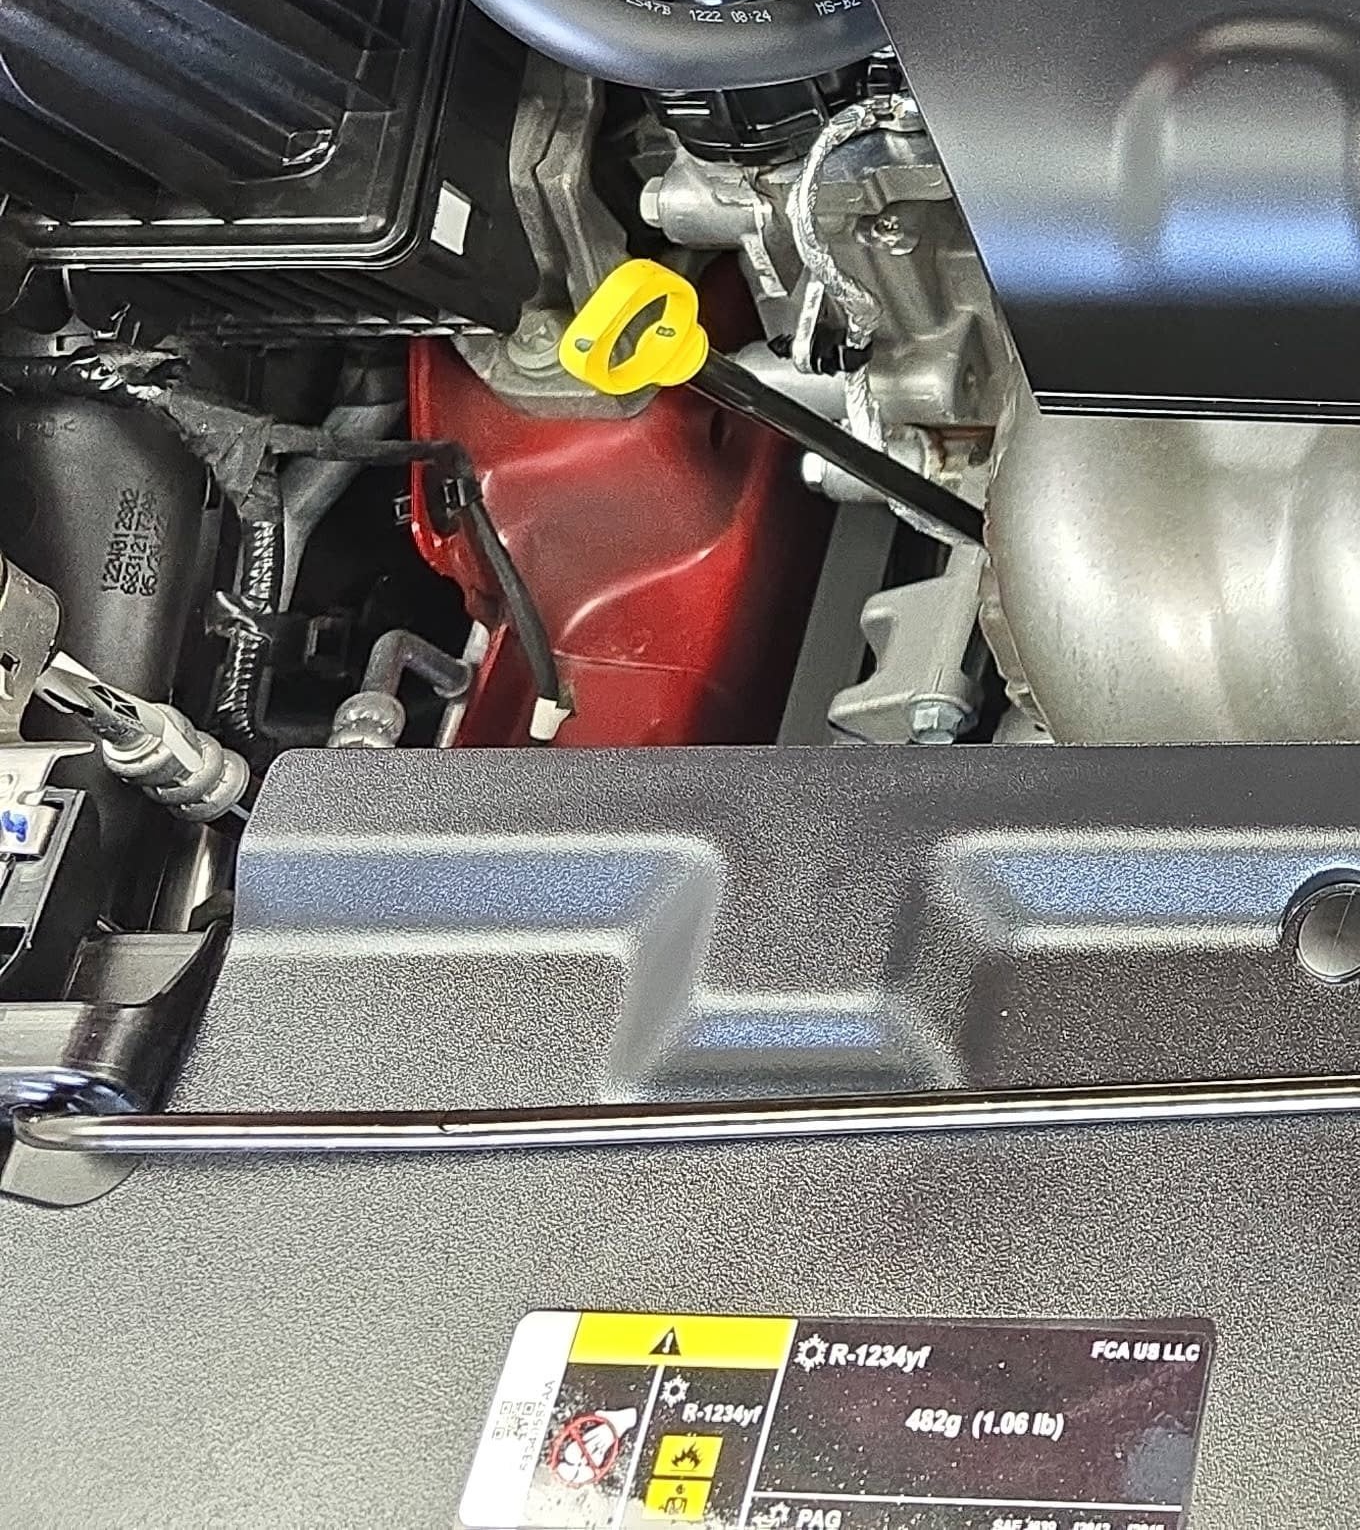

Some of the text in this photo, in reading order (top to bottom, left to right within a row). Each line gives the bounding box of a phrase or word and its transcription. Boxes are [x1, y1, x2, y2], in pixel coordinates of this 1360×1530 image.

[689, 8, 724, 23] 1222
[828, 1340, 1201, 1371] R-1234yf FCA US LLC
[682, 1403, 763, 1428] R-1234yf
[905, 1409, 1065, 1441] 482g (1.06 lb)
[796, 1508, 842, 1530] PAG
